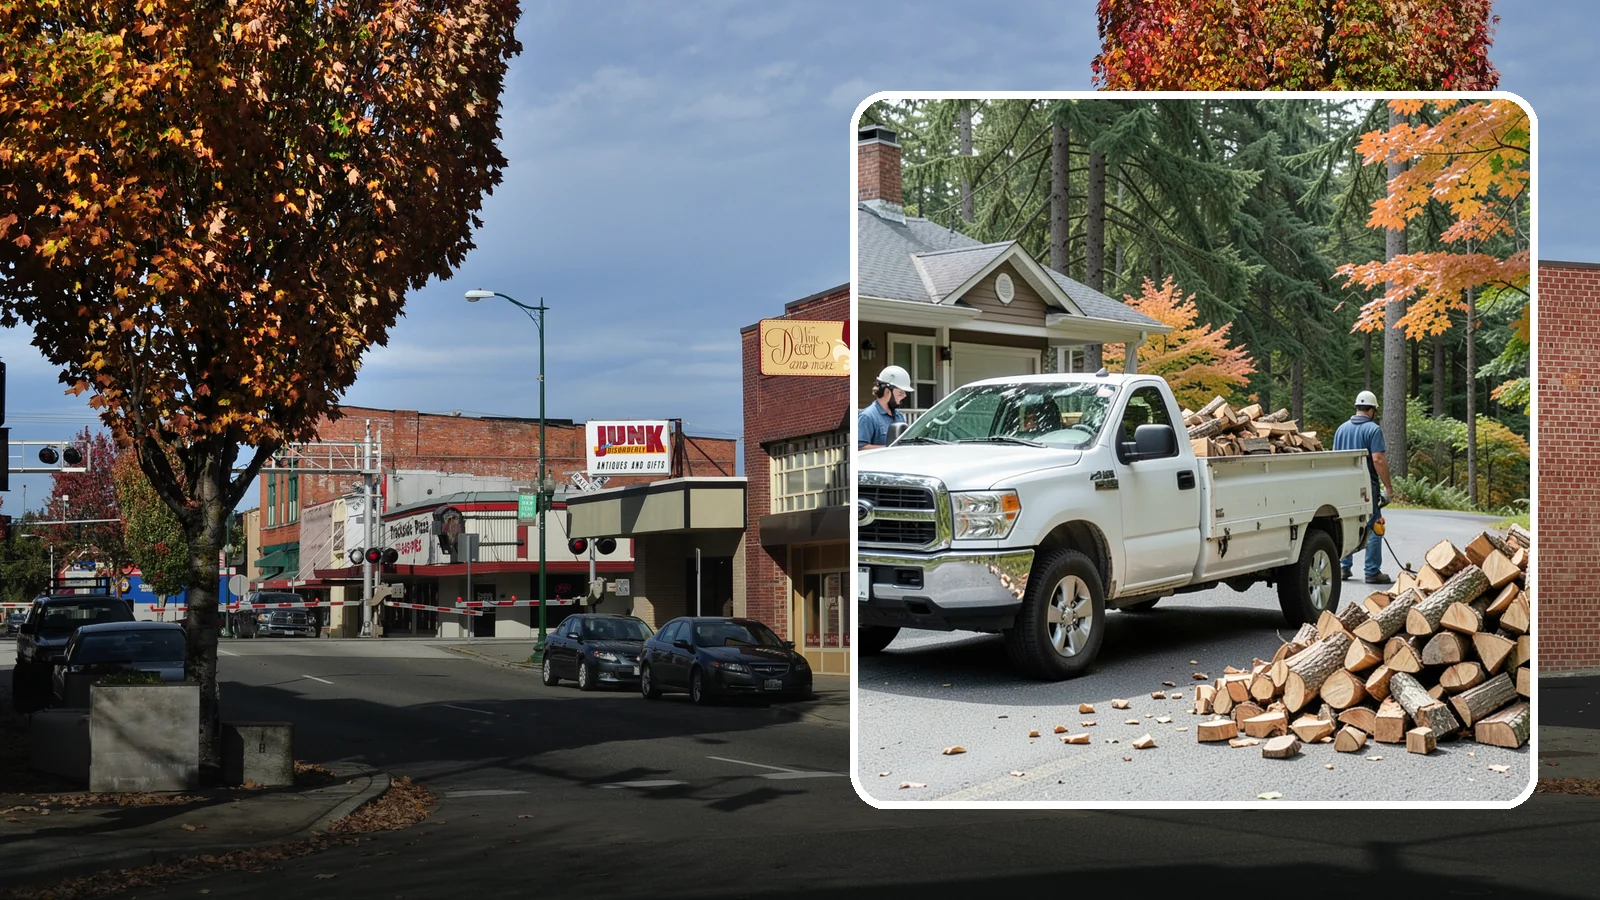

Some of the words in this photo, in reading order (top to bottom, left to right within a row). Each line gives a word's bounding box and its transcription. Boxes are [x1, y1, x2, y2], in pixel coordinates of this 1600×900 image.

[595, 425, 665, 457] JUNK
[607, 446, 645, 454] DISORDERLY
[597, 461, 628, 470] ANTIQUES
[631, 461, 644, 470] AND
[647, 460, 665, 469] GIFTS
[414, 519, 429, 535] Pizza
